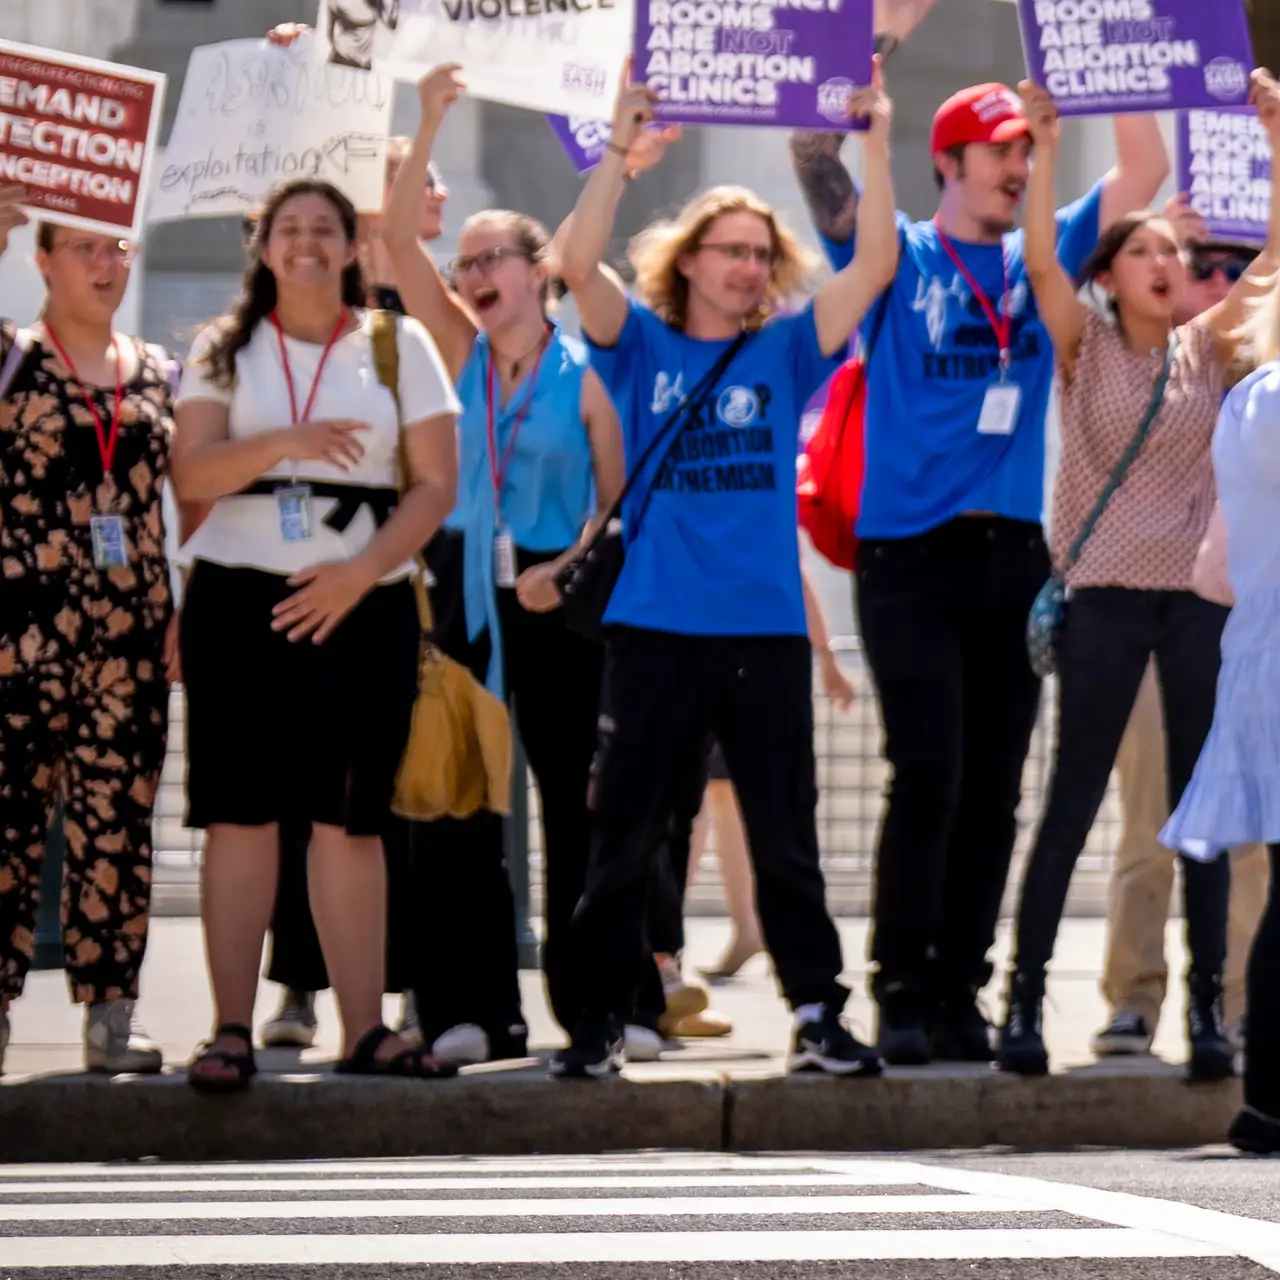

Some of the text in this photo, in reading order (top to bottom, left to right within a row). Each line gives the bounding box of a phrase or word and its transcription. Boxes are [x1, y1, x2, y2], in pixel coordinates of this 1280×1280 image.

[648, 0, 773, 31] ROOMS
[646, 25, 795, 54] ARE NOT
[1039, 17, 1175, 51] ARE NOT
[646, 50, 815, 84] ABORTION
[1042, 38, 1200, 74] ABORTION
[647, 74, 779, 105] CLINICS
[1046, 65, 1170, 97] CLINICS
[0, 74, 127, 130] EMAND
[0, 111, 145, 174] TECTION
[0, 152, 134, 205] NCEPTION
[159, 140, 325, 192] exploitation
